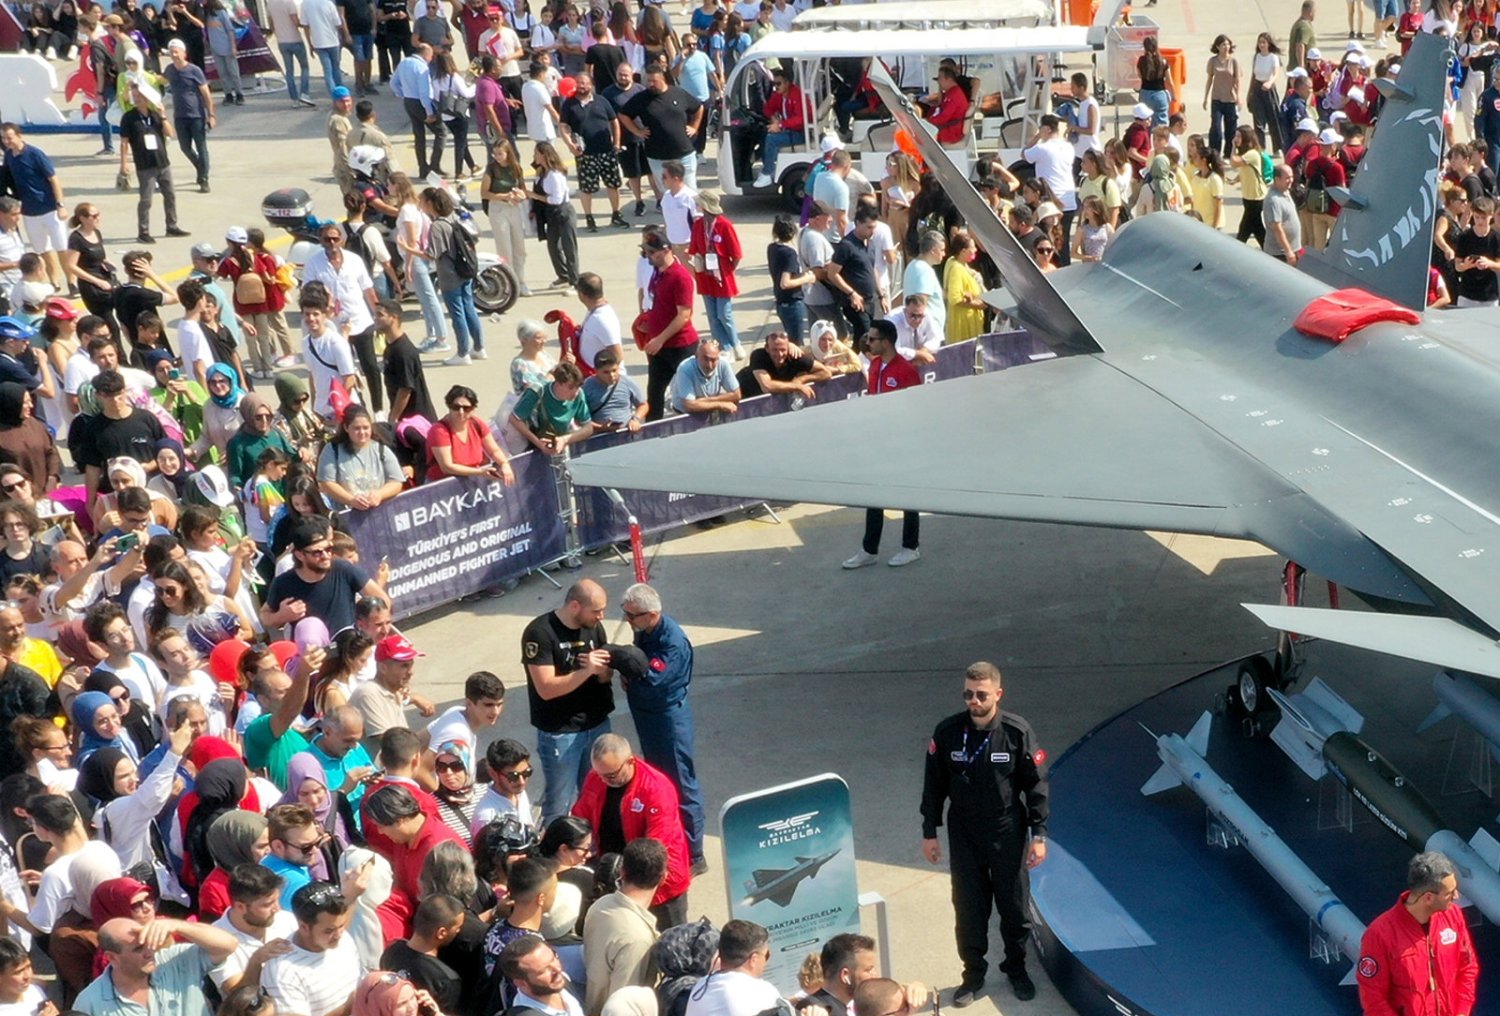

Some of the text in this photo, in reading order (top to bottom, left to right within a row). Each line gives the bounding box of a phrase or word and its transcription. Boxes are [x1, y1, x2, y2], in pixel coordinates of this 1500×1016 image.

[411, 482, 504, 528] BAYKAR
[453, 543, 478, 560] AND
[480, 522, 533, 552] ORIGINAL
[469, 515, 502, 538] FIRST
[388, 538, 531, 600] UNMANNED FIGHTER JET
[759, 826, 822, 849] KIZILELMA
